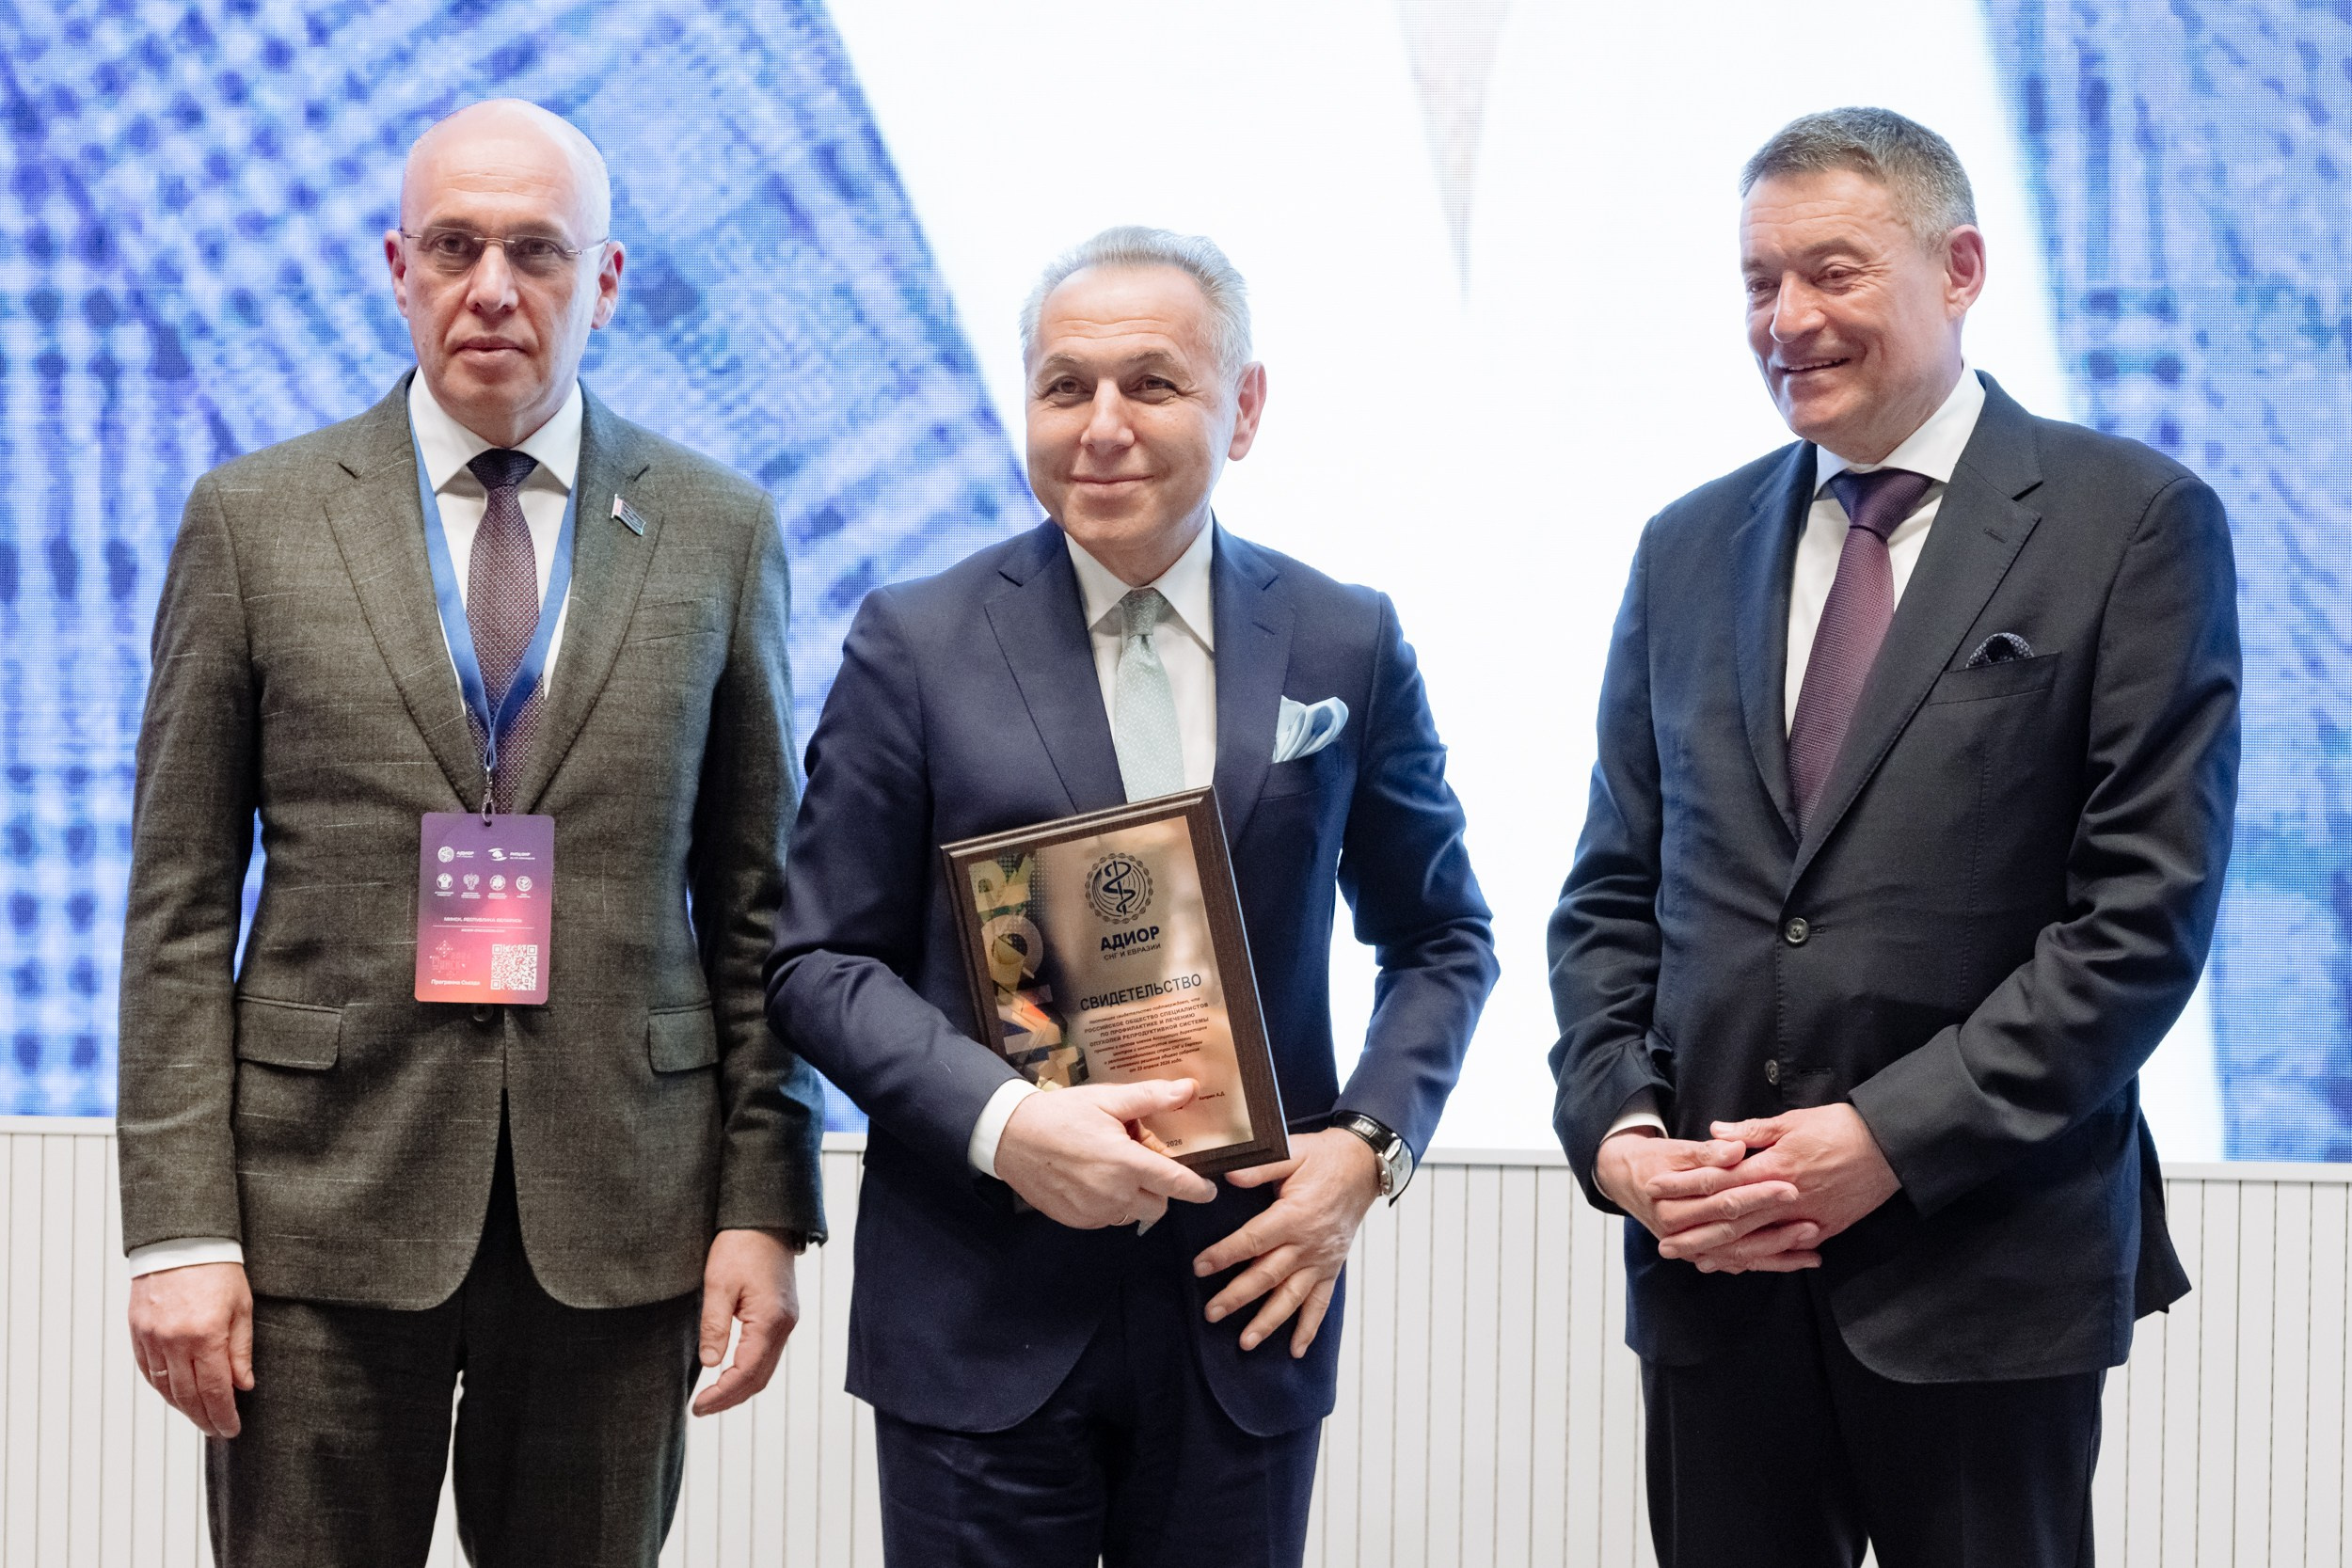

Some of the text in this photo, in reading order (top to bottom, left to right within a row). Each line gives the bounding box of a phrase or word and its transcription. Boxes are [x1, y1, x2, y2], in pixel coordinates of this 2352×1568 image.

[1099, 926, 1162, 953] АДИОР
[1127, 943, 1161, 956] ЕВРАЗИИ
[1080, 974, 1202, 1012] СВИДЕТЕЛЬСТВО
[1085, 1003, 1209, 1034] РОССИЙСКОЕ ОБЩЕСТВО СПЕЦИАЛИСТОВ
[1110, 1022, 1158, 1035] ПРОФИЛАКТИКЕ
[1166, 1013, 1196, 1022] ЛЕЧЕНИЮ
[1117, 1008, 1152, 1019] свидетельство
[1090, 1018, 1209, 1047] ОПУХОЛЕЙ РЕПРОДУКТИВНОЙ СИСТЕМЫ
[1180, 1026, 1208, 1035] директоров
[1167, 1139, 1184, 1148] 2026
